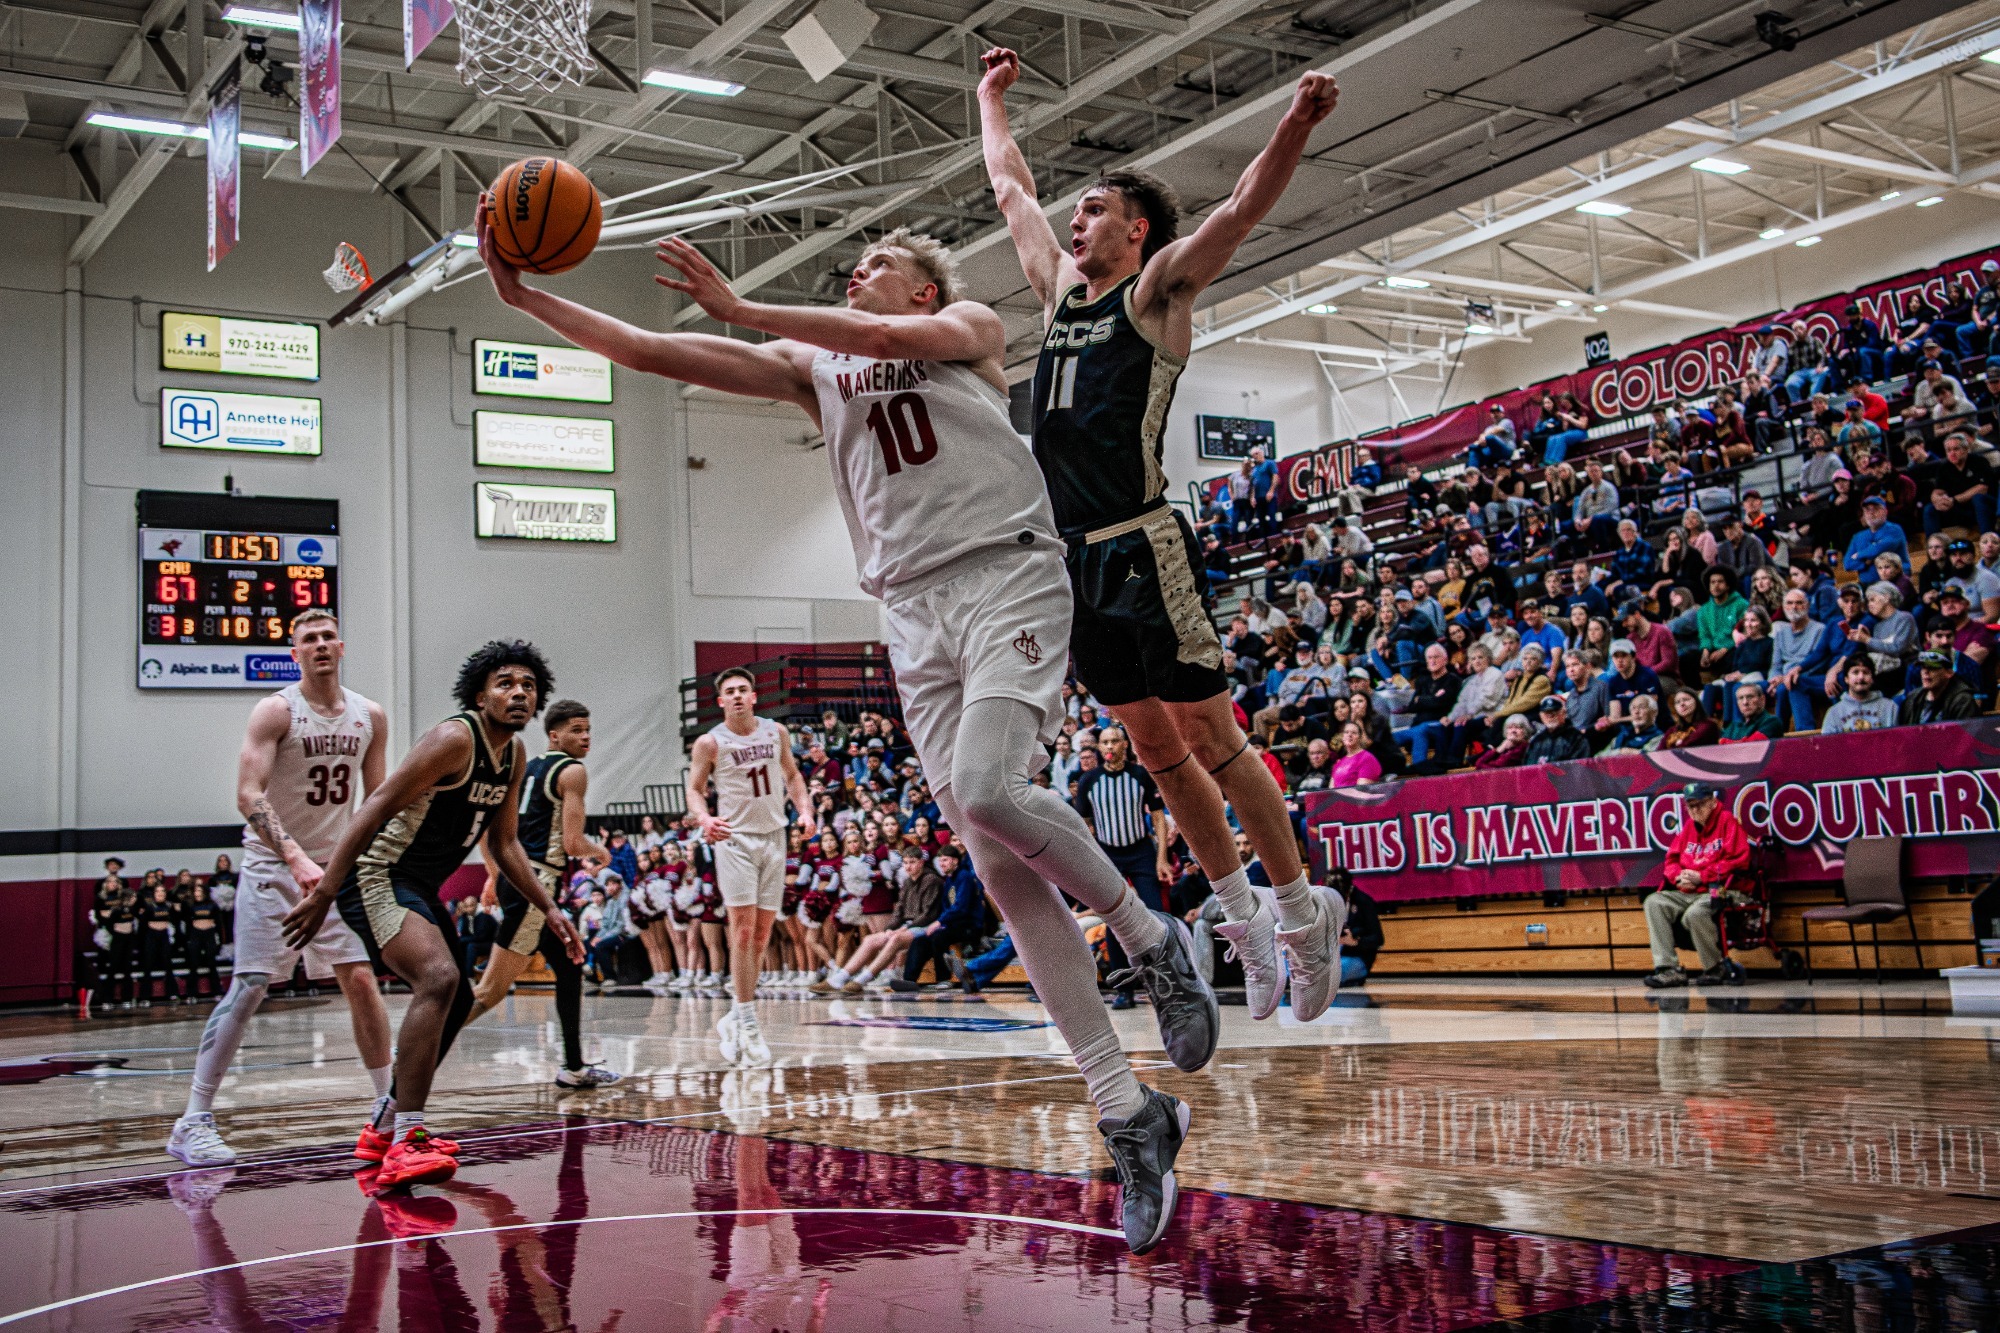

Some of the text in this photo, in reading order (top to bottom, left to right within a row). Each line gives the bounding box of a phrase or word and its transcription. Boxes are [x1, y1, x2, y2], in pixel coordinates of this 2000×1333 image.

[515, 159, 548, 222] Wilson
[167, 347, 221, 358] HAINING
[228, 338, 309, 354] 970-242-4429
[1585, 337, 1610, 361] 102
[1591, 309, 1842, 419] COLORAO
[227, 411, 319, 430] Annette Hejl
[866, 392, 938, 476] 10
[1289, 443, 1359, 502] CMU
[492, 499, 607, 537] KNOWLES
[213, 535, 279, 561] 11:57
[287, 566, 325, 580] UCCS
[160, 576, 197, 603] 67
[234, 580, 250, 602] 2
[294, 579, 329, 606] 51
[261, 607, 277, 616] PTS
[161, 615, 176, 637] 3
[183, 618, 195, 635] 3
[268, 617, 283, 639] 5
[170, 663, 240, 676] Alpine Bank
[302, 734, 360, 758] MAVERICKS
[306, 764, 350, 807] 33
[746, 765, 771, 797] 11
[1319, 818, 1405, 873] THIS
[1412, 812, 1456, 868] IS
[1464, 793, 1688, 864] MAVERIC
